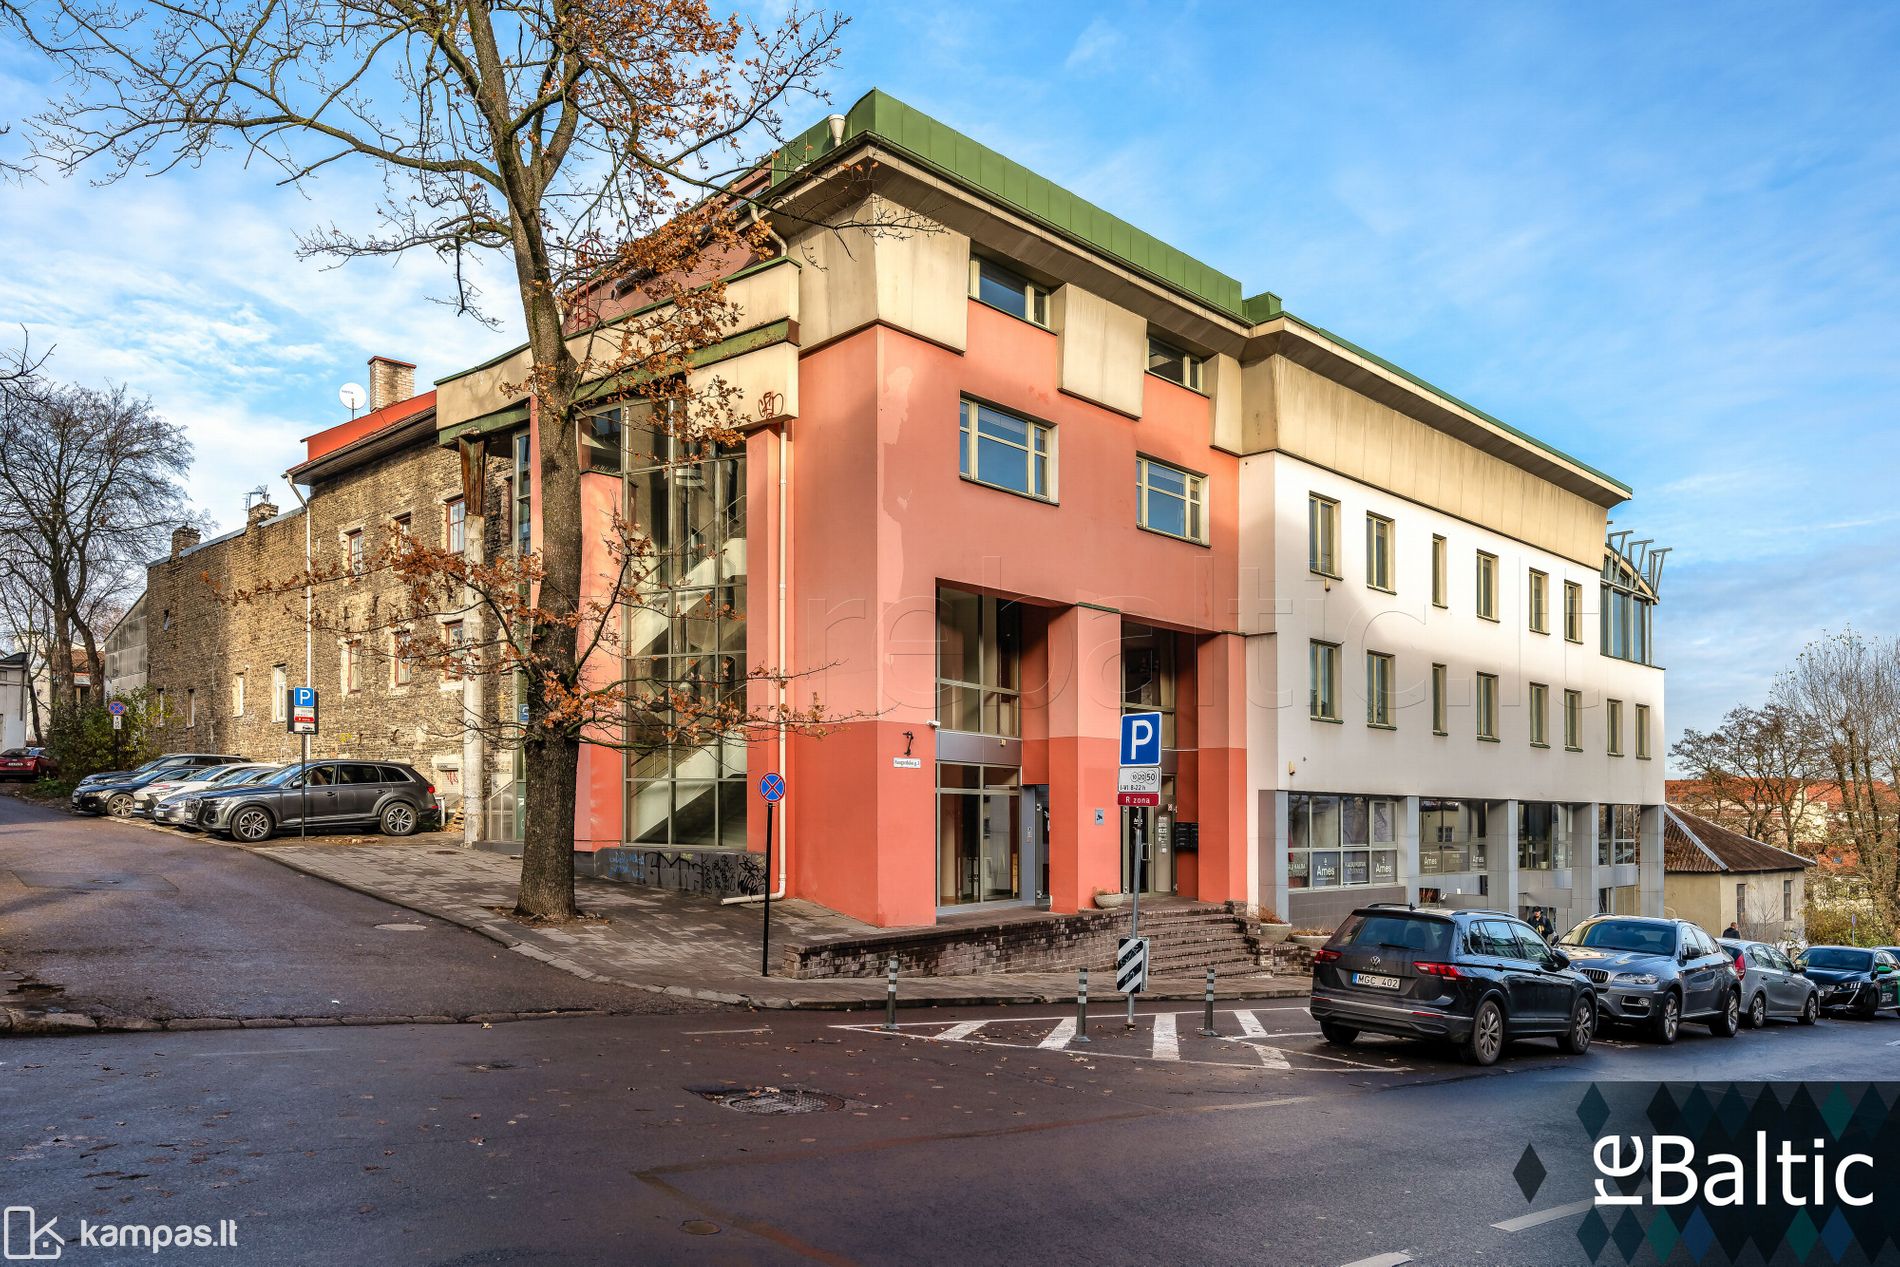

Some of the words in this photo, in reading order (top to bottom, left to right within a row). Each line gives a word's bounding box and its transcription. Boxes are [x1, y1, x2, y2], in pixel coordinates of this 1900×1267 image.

[300, 689, 311, 705] P
[1130, 719, 1154, 761] P
[1146, 773, 1156, 781] 50
[1125, 796, 1131, 804] R
[1316, 865, 1335, 876] Ames
[1375, 863, 1392, 873] Ames
[1357, 974, 1377, 985] MGC
[1381, 978, 1398, 988] 402
